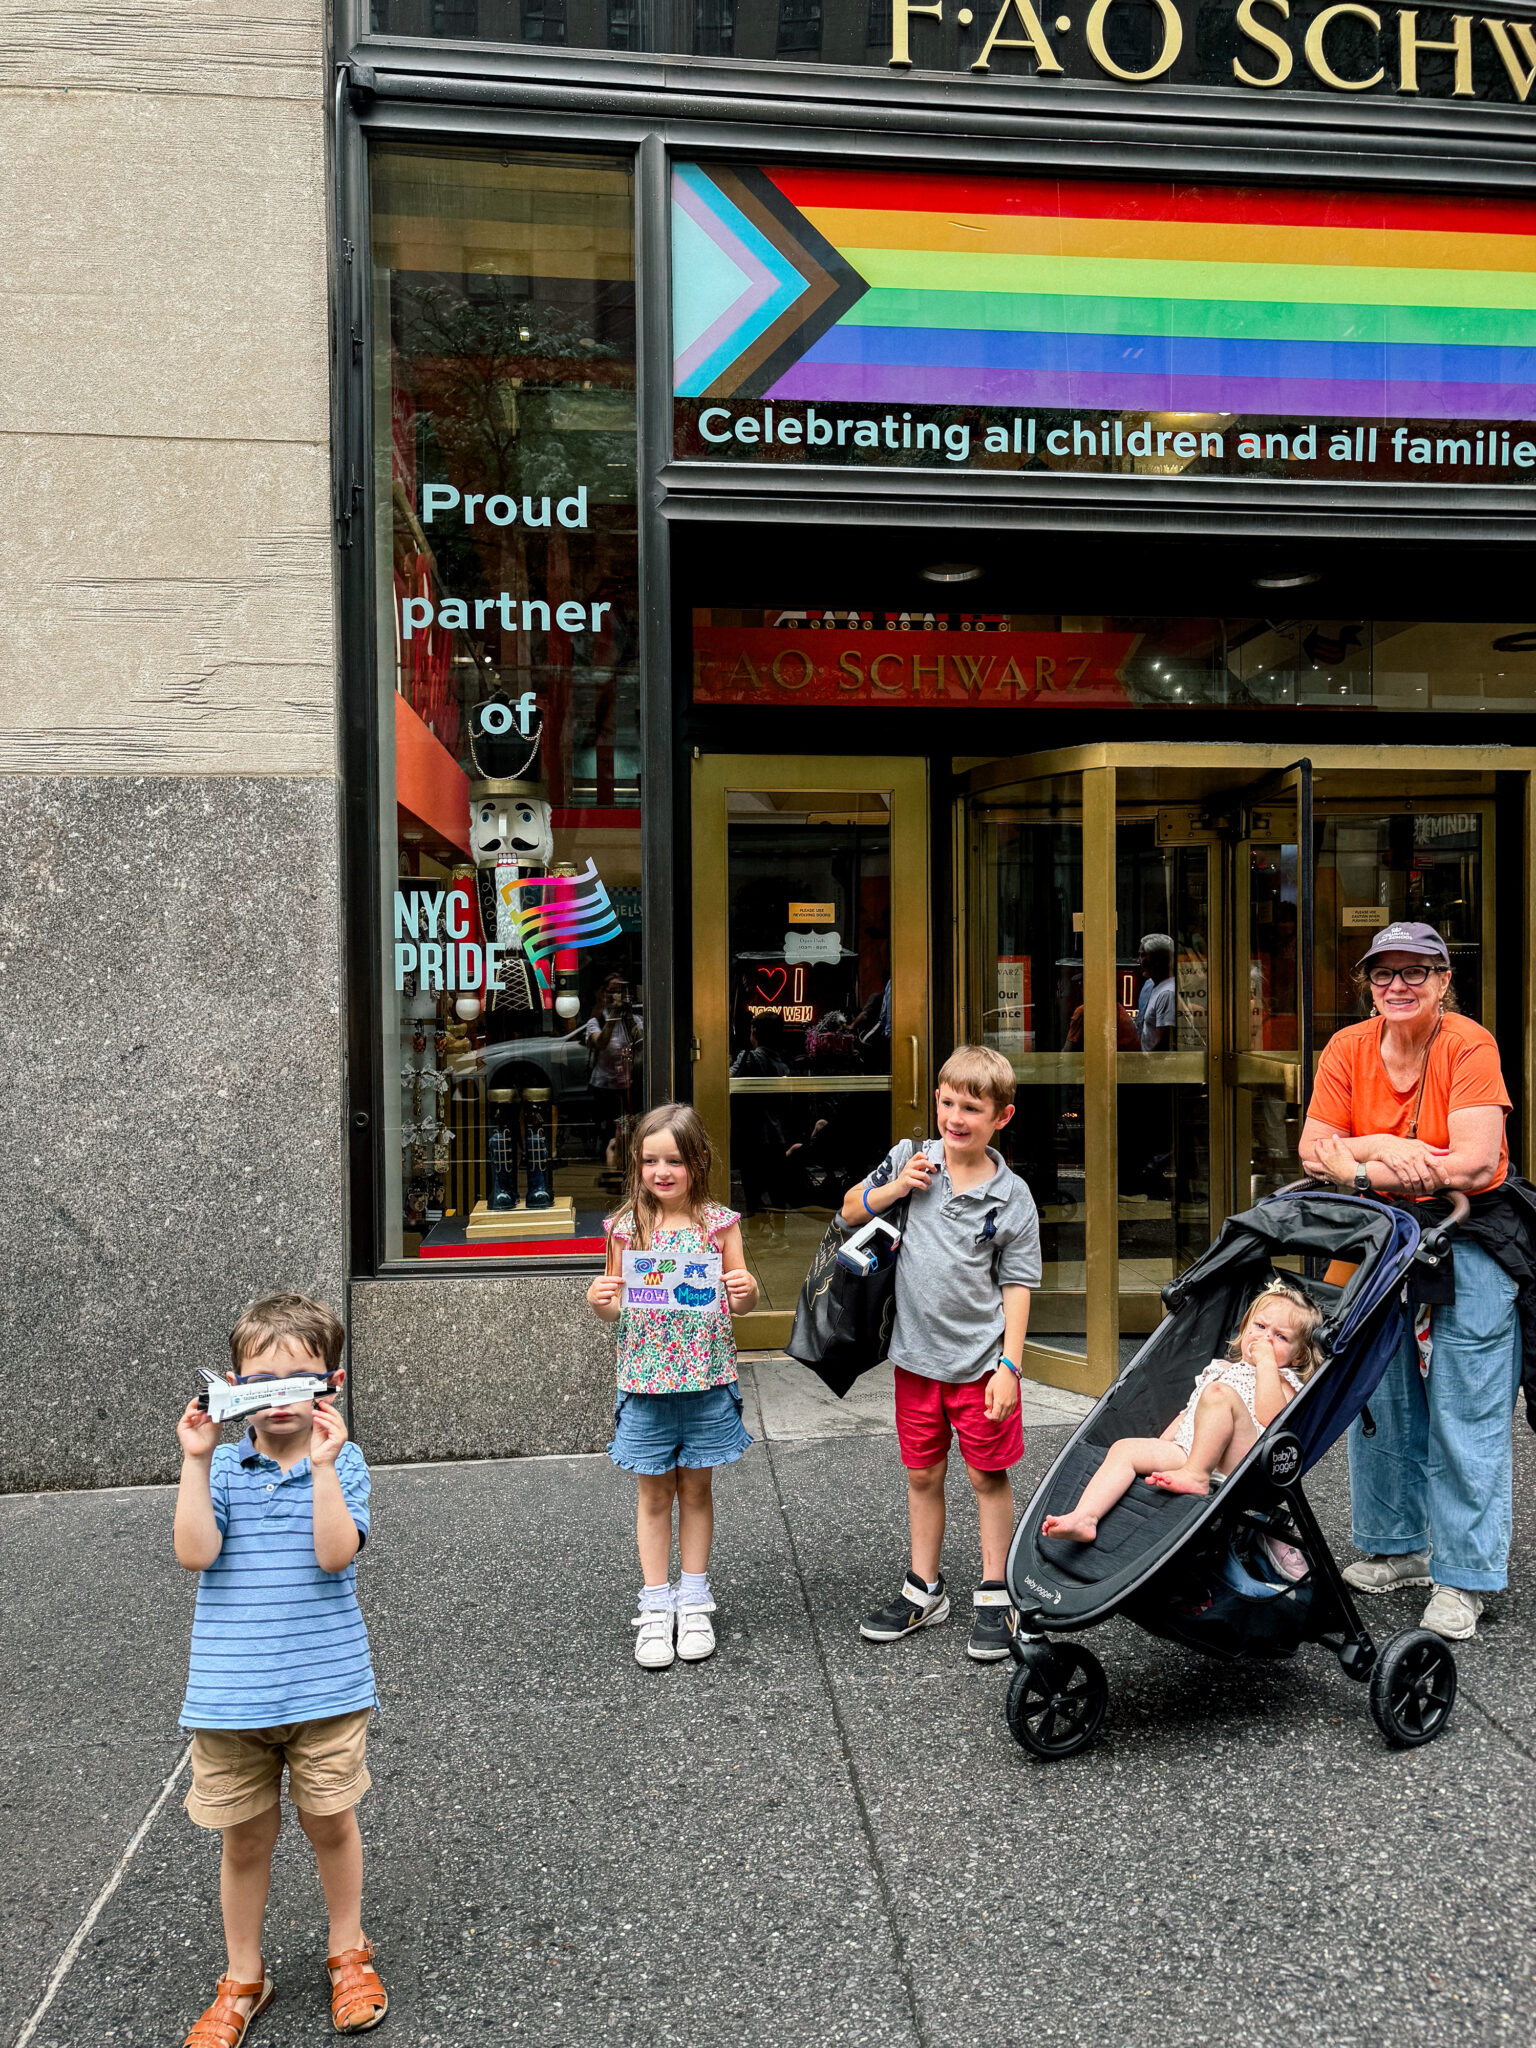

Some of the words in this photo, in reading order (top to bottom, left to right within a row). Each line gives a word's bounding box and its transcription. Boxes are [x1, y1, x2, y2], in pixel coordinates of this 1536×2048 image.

[698, 407, 970, 461] Celebrating
[984, 418, 1036, 454] all
[1046, 420, 1224, 458] children
[1237, 425, 1317, 460] and
[1328, 427, 1377, 462] all
[1391, 427, 1536, 468] familie
[422, 483, 588, 528] Proud
[402, 592, 611, 640] partner
[838, 650, 1093, 692] SCHWARZ
[480, 692, 537, 735] of
[393, 891, 471, 940] NYC
[394, 943, 507, 992] PRIDE
[1271, 1460, 1297, 1475] jogger
[1272, 1450, 1291, 1463] baby
[1024, 1574, 1038, 1590] baby
[1034, 1584, 1055, 1600] jogger
